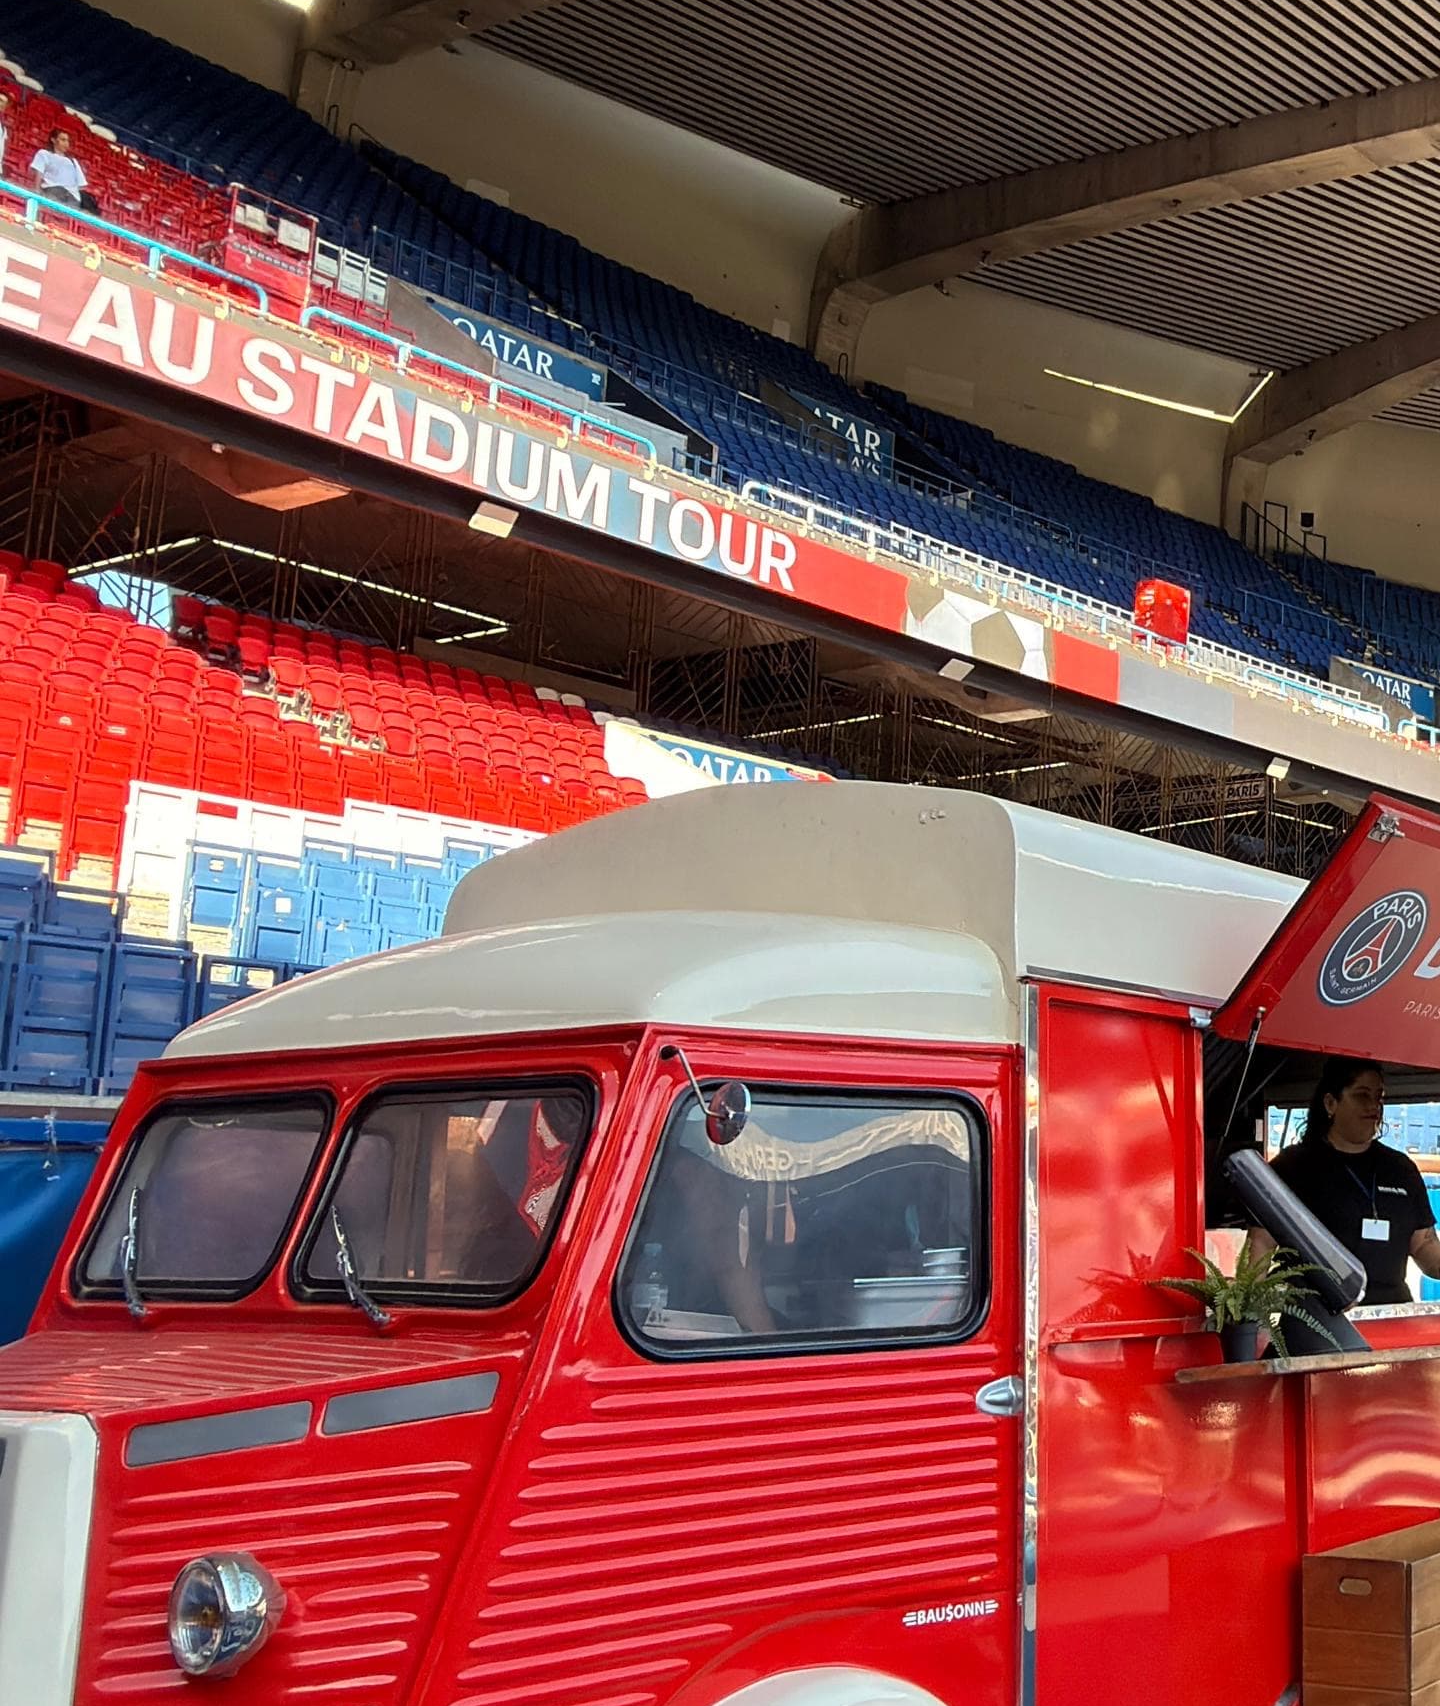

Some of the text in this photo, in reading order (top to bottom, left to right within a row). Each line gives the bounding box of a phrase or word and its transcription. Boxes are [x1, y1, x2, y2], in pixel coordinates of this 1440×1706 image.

[67, 276, 216, 385] AU
[236, 338, 612, 530] STADIUM
[628, 476, 798, 593] TOUR
[1373, 898, 1422, 929] PARIS
